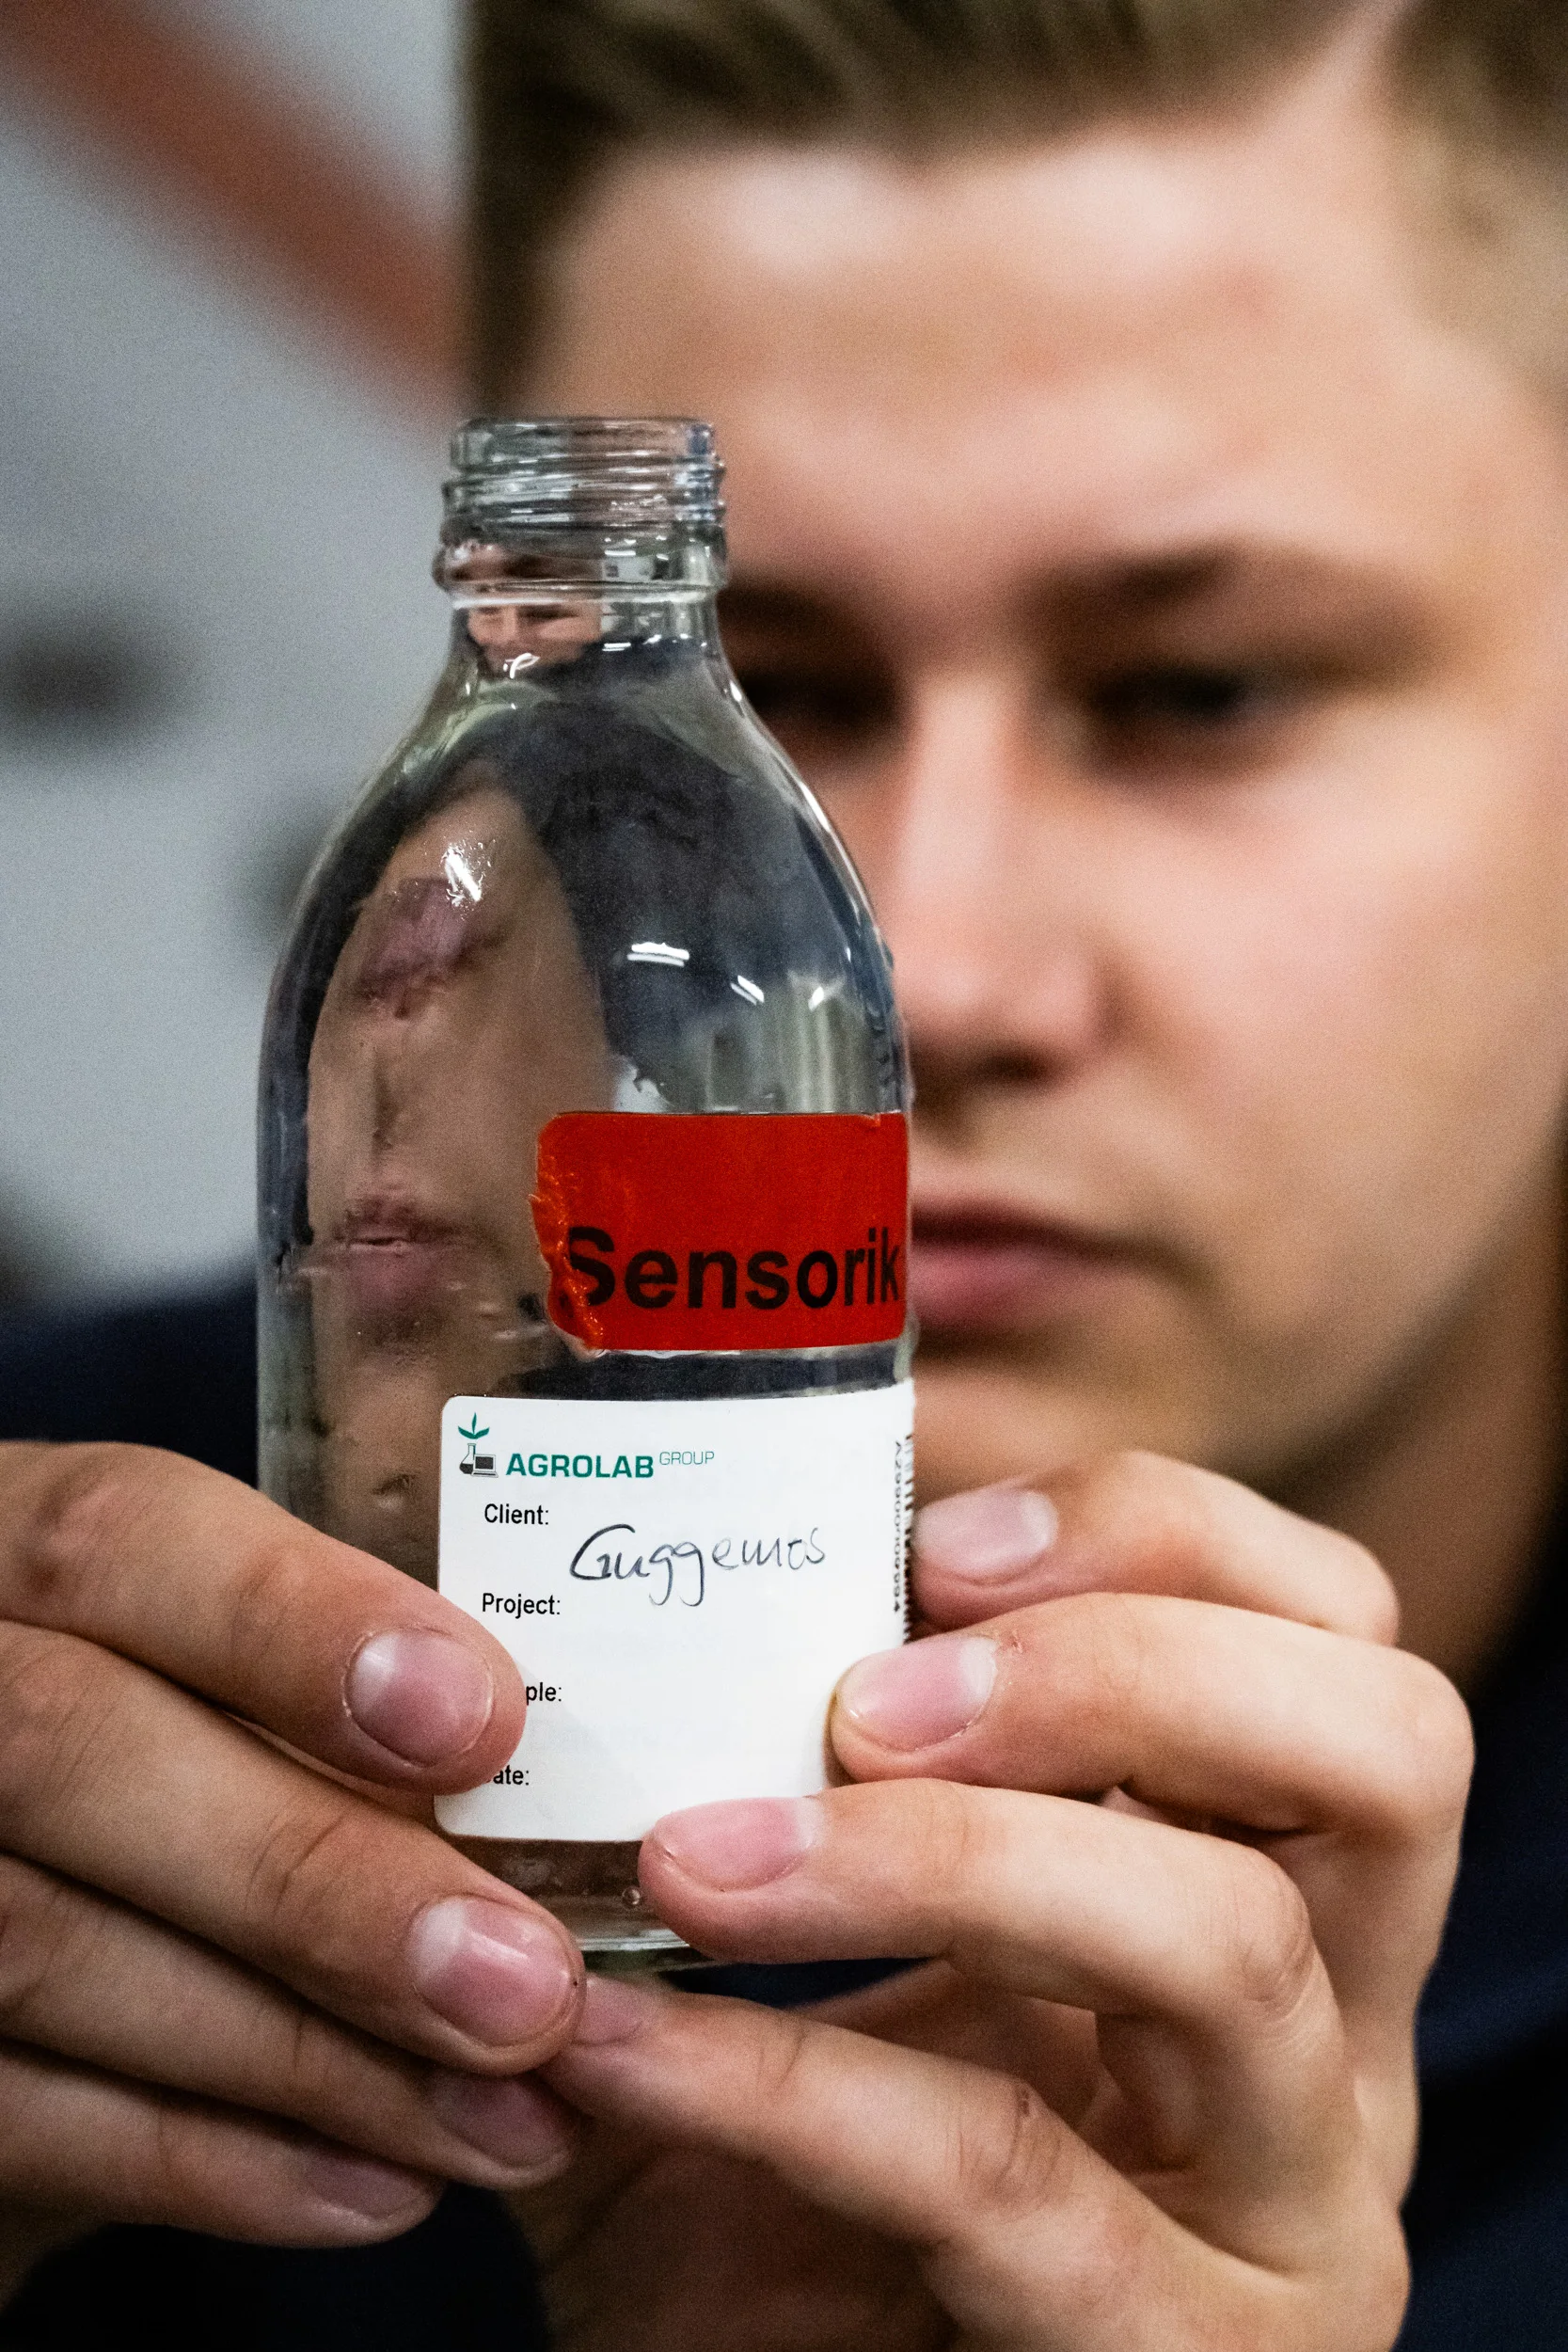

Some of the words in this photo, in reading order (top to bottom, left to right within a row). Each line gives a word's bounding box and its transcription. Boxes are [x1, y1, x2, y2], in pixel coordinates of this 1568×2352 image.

[565, 1226, 900, 1310] Sensorik
[506, 1453, 654, 1479] AGROLAB
[658, 1451, 715, 1466] GROUP
[483, 1502, 549, 1525] Client:
[482, 1592, 561, 1619] Project:
[525, 1681, 562, 1707] ple:
[491, 1764, 530, 1786] ate:
